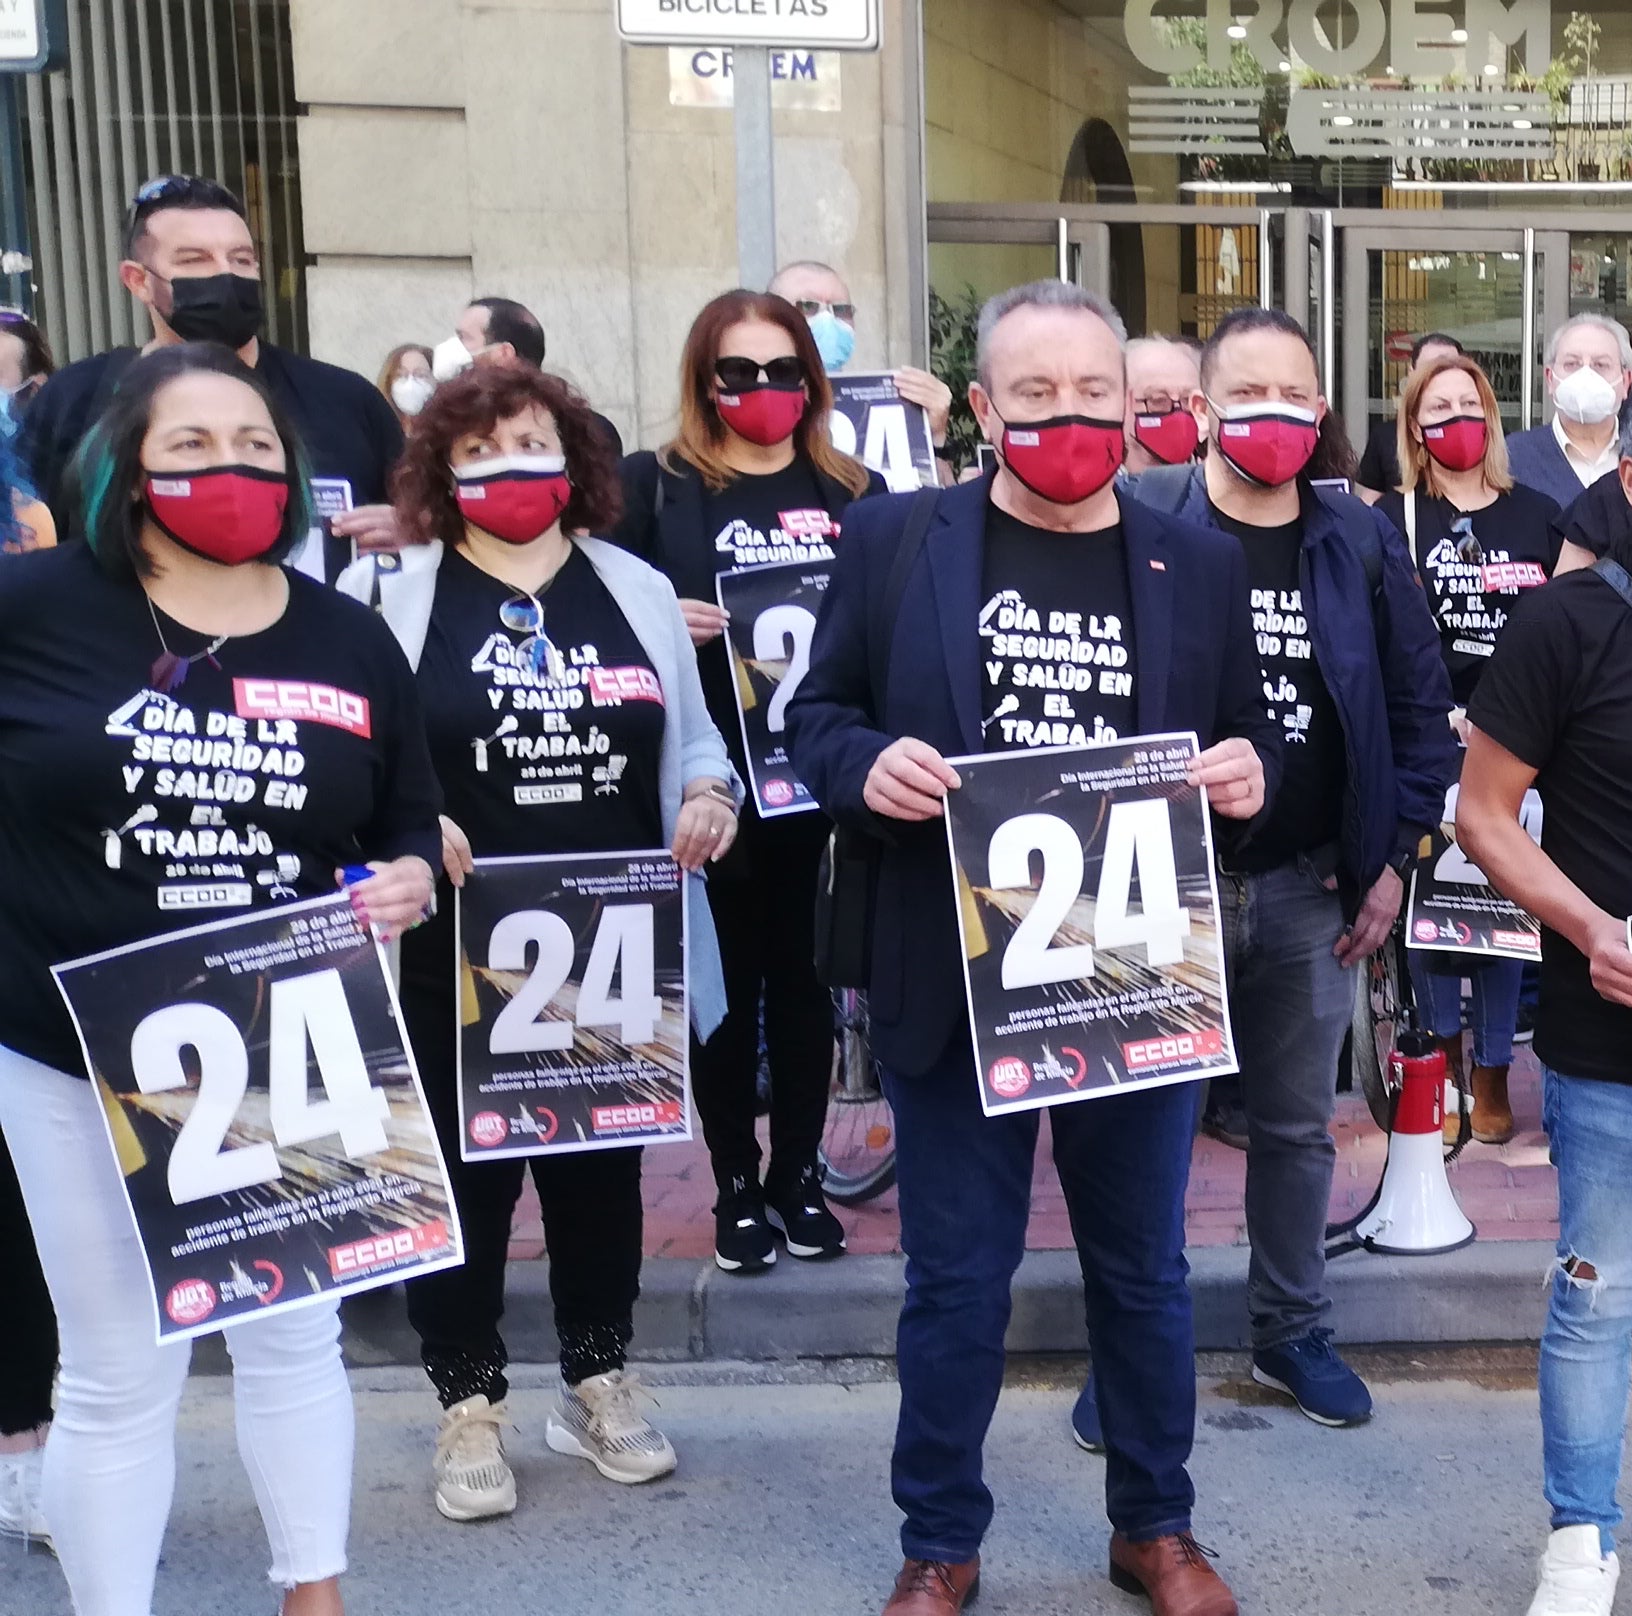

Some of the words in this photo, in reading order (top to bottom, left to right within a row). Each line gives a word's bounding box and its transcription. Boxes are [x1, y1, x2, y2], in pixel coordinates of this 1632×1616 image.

[658, 0, 828, 16] BICICLETAS
[1123, 0, 1551, 75] CROEM
[691, 51, 818, 81] CREM
[734, 545, 836, 564] SEGURIDAD
[1433, 580, 1443, 595] Y
[1449, 579, 1484, 594] SALU
[1486, 563, 1543, 585] CCOO
[1250, 589, 1276, 609] DE
[1280, 590, 1303, 611] LA
[1467, 596, 1485, 611] EL
[1049, 612, 1082, 634] DE
[1252, 612, 1307, 635] RIDAD
[992, 633, 1128, 667] SEGURIDAD
[1285, 638, 1311, 659] EN
[753, 605, 816, 732] 2
[986, 661, 1003, 685] Y
[1012, 664, 1092, 692] SALUD
[1099, 671, 1133, 696] EN
[244, 682, 365, 725] CCOO
[487, 688, 504, 709] Y
[513, 688, 584, 710] SALUD
[1044, 694, 1075, 718] EL
[207, 712, 247, 738] DE
[544, 712, 571, 733] EL
[1000, 718, 1117, 747] TRABAJO
[133, 736, 305, 777] SEGURIDAD
[502, 733, 610, 760] TRABAJO
[1149, 749, 1164, 762] de
[1165, 746, 1190, 760] abril
[123, 766, 144, 794] Y
[155, 769, 256, 803] SALUD
[264, 778, 308, 811] EN
[190, 805, 227, 826] EL
[135, 828, 273, 858] TRABAJO
[988, 797, 1191, 990] 24
[308, 913, 328, 931] de
[488, 902, 662, 1055] 24
[1129, 1037, 1194, 1063] CCOO
[131, 969, 392, 1206] 24
[596, 1106, 655, 1126] CCOO
[335, 1237, 415, 1270] CCOO
